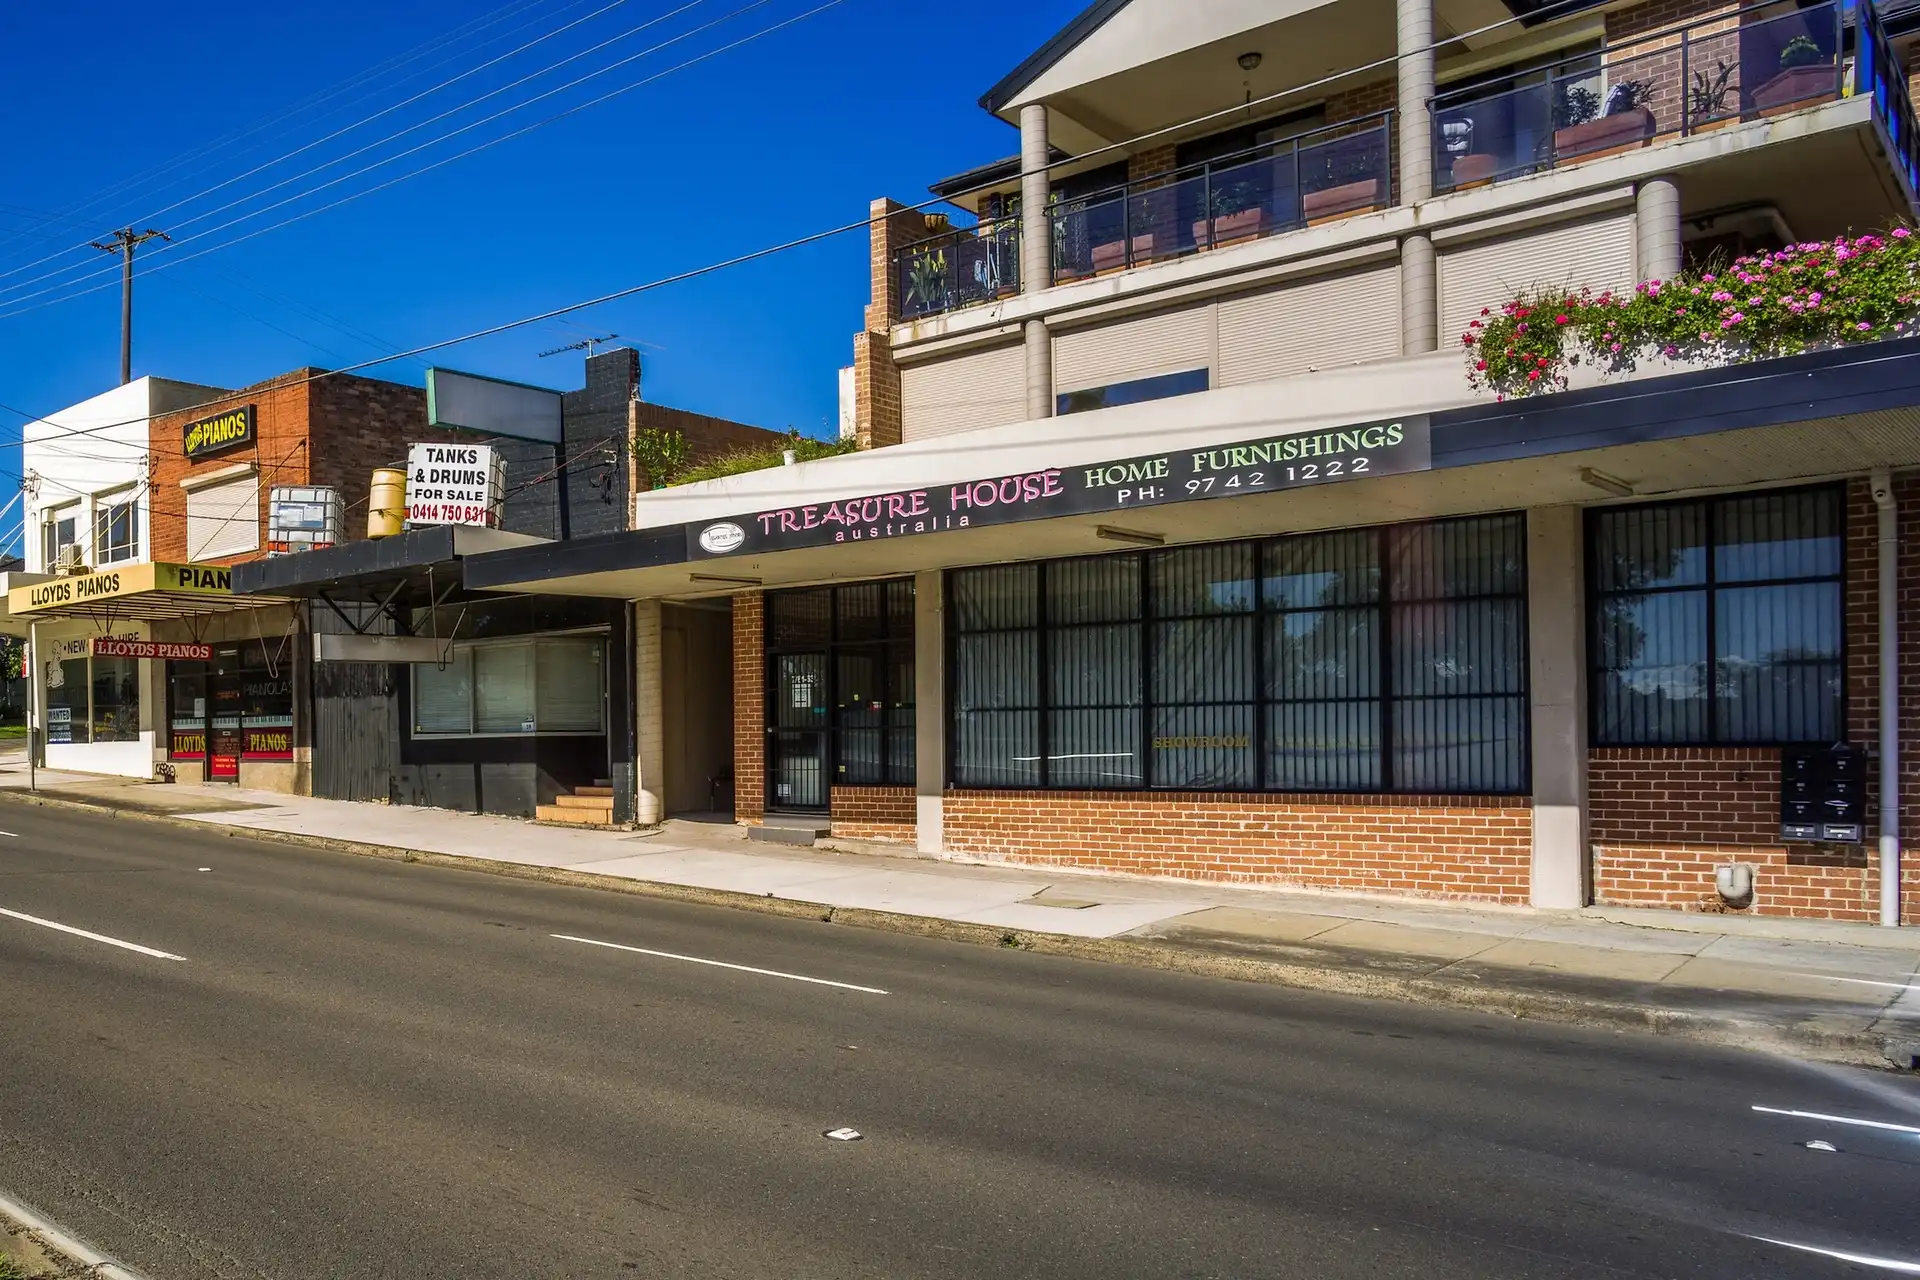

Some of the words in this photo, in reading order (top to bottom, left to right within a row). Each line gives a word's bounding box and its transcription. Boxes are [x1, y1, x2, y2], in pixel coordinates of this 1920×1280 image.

[203, 412, 245, 446] PIANOS
[426, 448, 477, 464] TANKS
[1084, 457, 1169, 489] HOME
[1192, 423, 1404, 473] FURNISHINGS
[415, 468, 425, 483] &
[430, 469, 485, 486] DRUMS
[1117, 487, 1165, 503] PH:
[1185, 472, 1265, 494] 9742
[1287, 457, 1369, 481] 1222
[415, 488, 443, 499] FOR
[447, 490, 483, 501] SALE
[757, 491, 929, 535] TREASURE
[950, 469, 1064, 510] HOUSE
[413, 504, 438, 520] 0414
[442, 505, 461, 521] 750
[465, 506, 483, 522] 631
[835, 514, 970, 542] australia
[31, 583, 70, 606] LLOYDS
[77, 574, 119, 598] PIANOS
[67, 640, 86, 654] NEW
[97, 641, 155, 656] LLOYDS
[158, 643, 209, 658] PIANOS
[174, 736, 206, 752] LLOYDS
[250, 733, 287, 751] PIANOS
[1152, 735, 1249, 748] SHOWROOM
